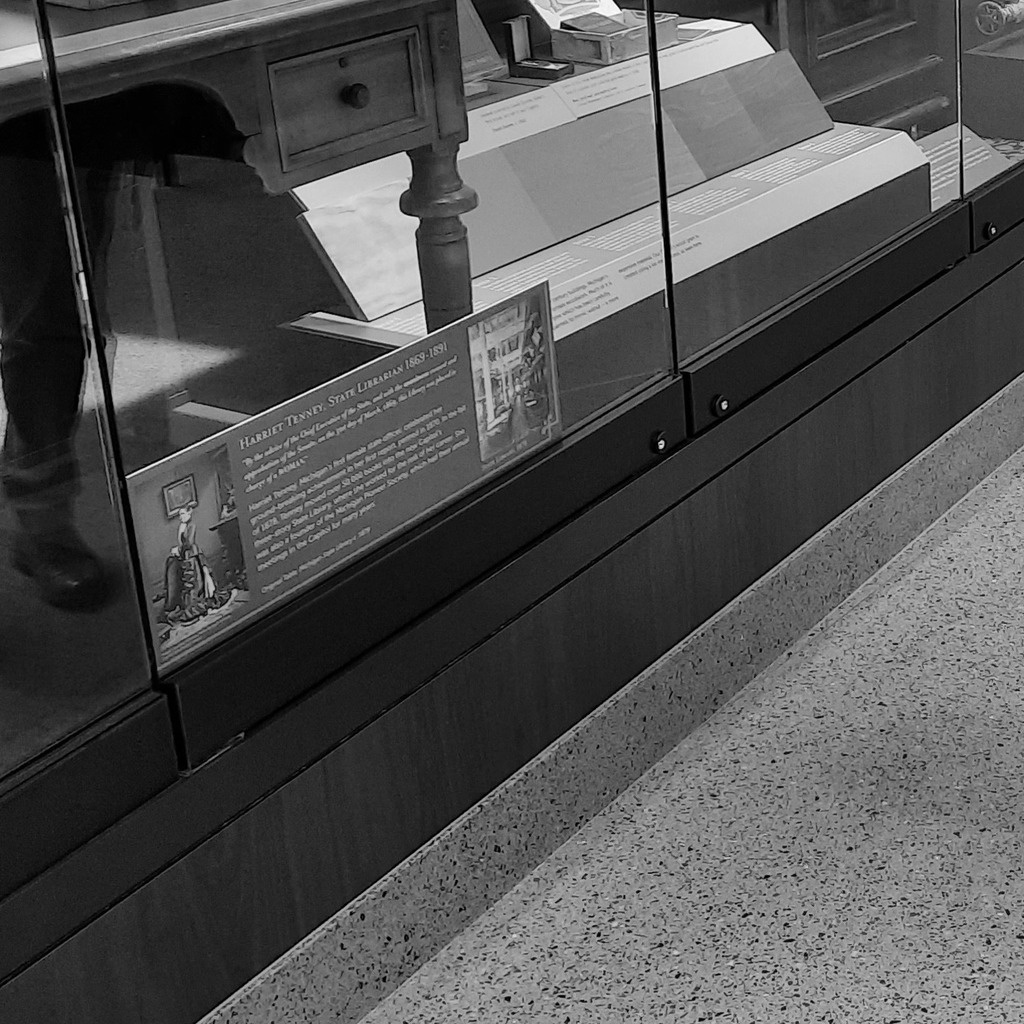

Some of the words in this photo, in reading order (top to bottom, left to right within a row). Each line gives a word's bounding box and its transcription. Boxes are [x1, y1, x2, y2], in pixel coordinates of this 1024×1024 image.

[239, 422, 284, 450] HARRIET
[328, 386, 356, 408] STATE
[357, 364, 404, 393] LIBRARIAN
